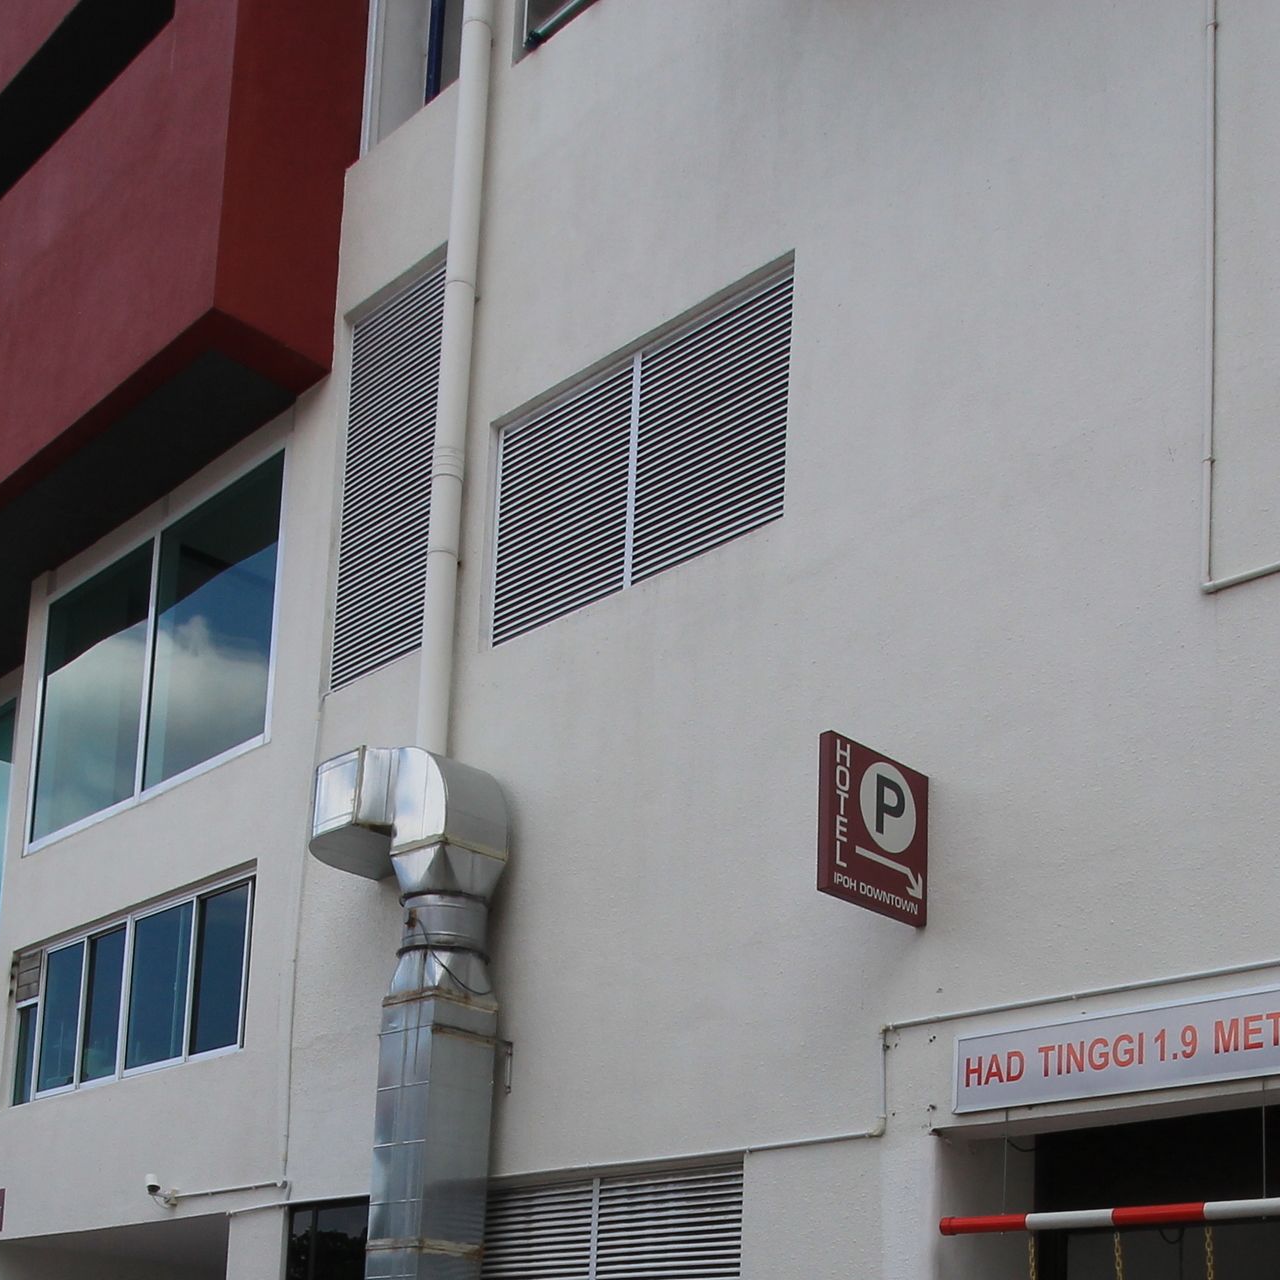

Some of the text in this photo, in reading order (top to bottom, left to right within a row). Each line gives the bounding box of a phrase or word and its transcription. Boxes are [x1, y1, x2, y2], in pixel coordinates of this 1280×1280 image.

[835, 738, 851, 868] HOTEL
[875, 773, 905, 835] P
[833, 871, 919, 915] IPOH DOWNTOWN
[964, 1050, 1025, 1088] HAD
[1038, 1032, 1145, 1078] TINGGI
[1154, 1024, 1199, 1062] 1.9
